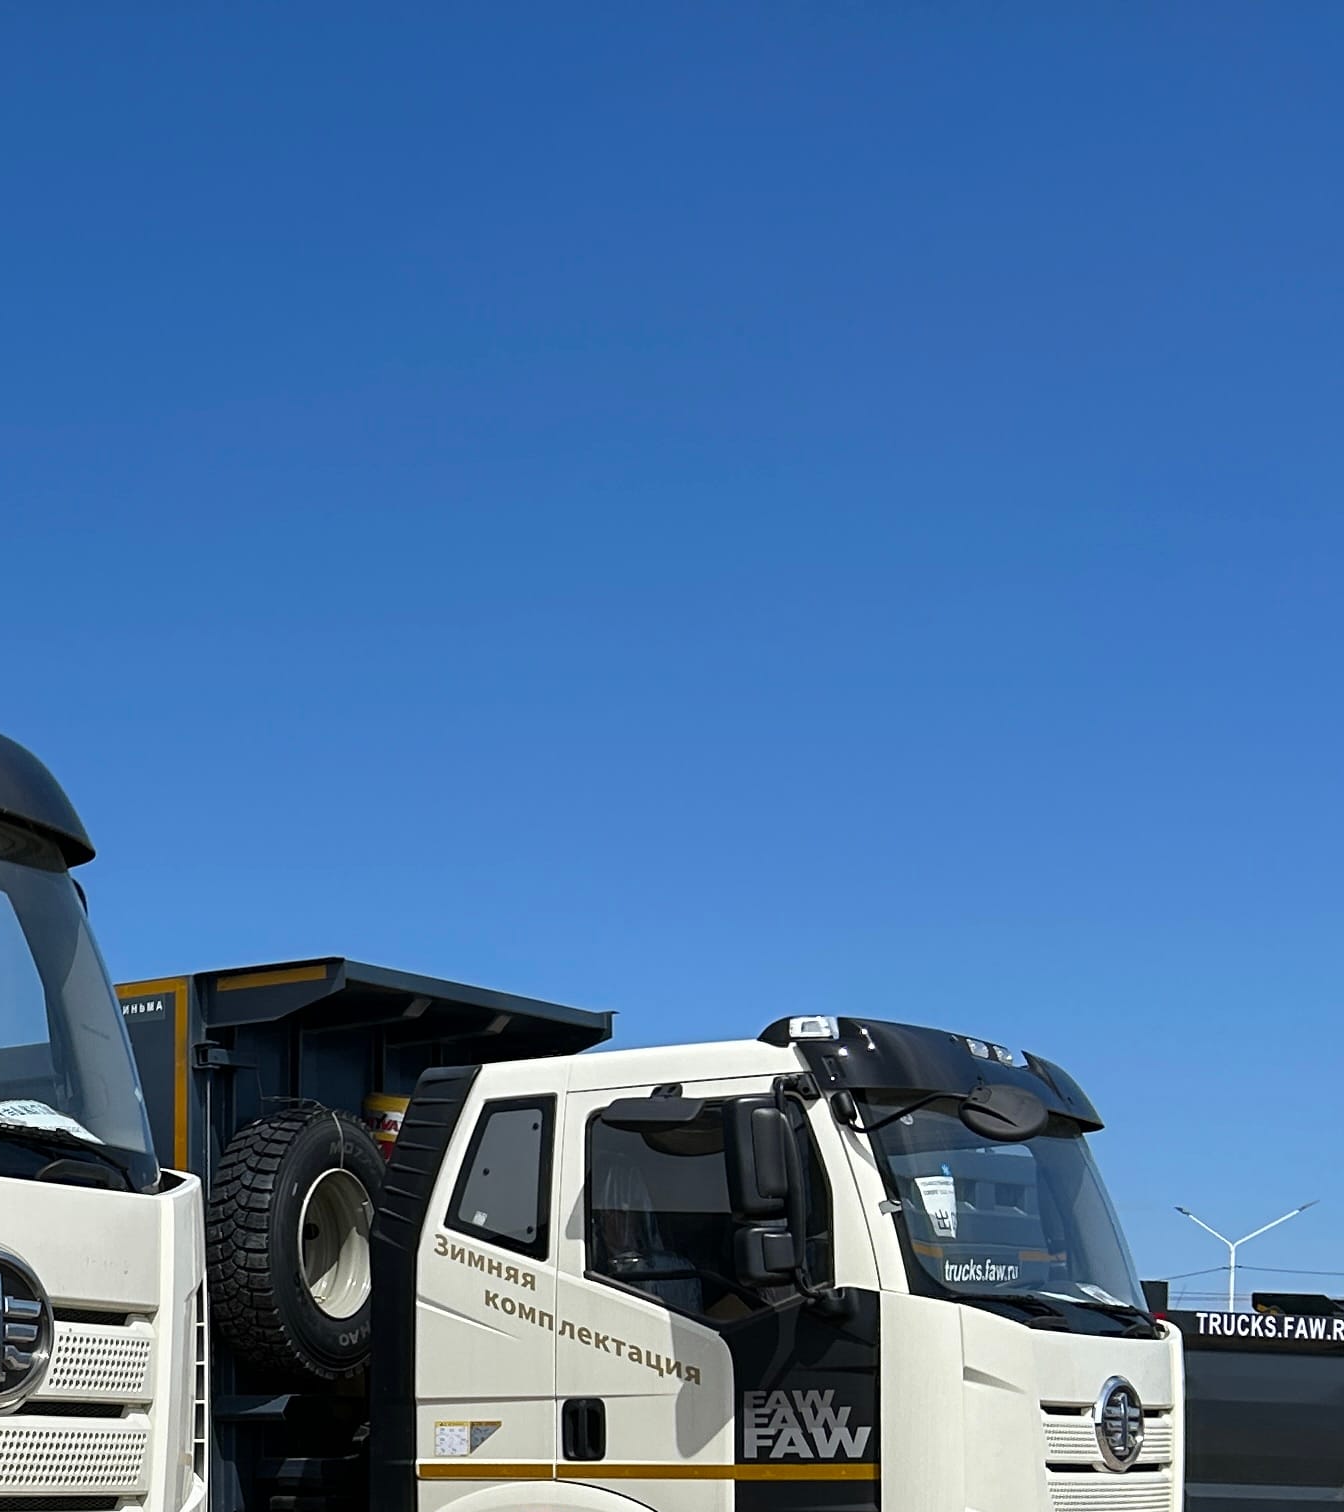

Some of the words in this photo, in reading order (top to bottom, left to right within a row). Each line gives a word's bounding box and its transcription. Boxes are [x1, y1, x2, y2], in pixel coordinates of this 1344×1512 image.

[432, 1233, 537, 1292] Зимняя
[944, 1259, 1019, 1282] trucks.faw.ru
[484, 1289, 702, 1386] комплектация
[1195, 1312, 1344, 1341] TRUCKS.FAW.R
[743, 1426, 872, 1459] FAW
